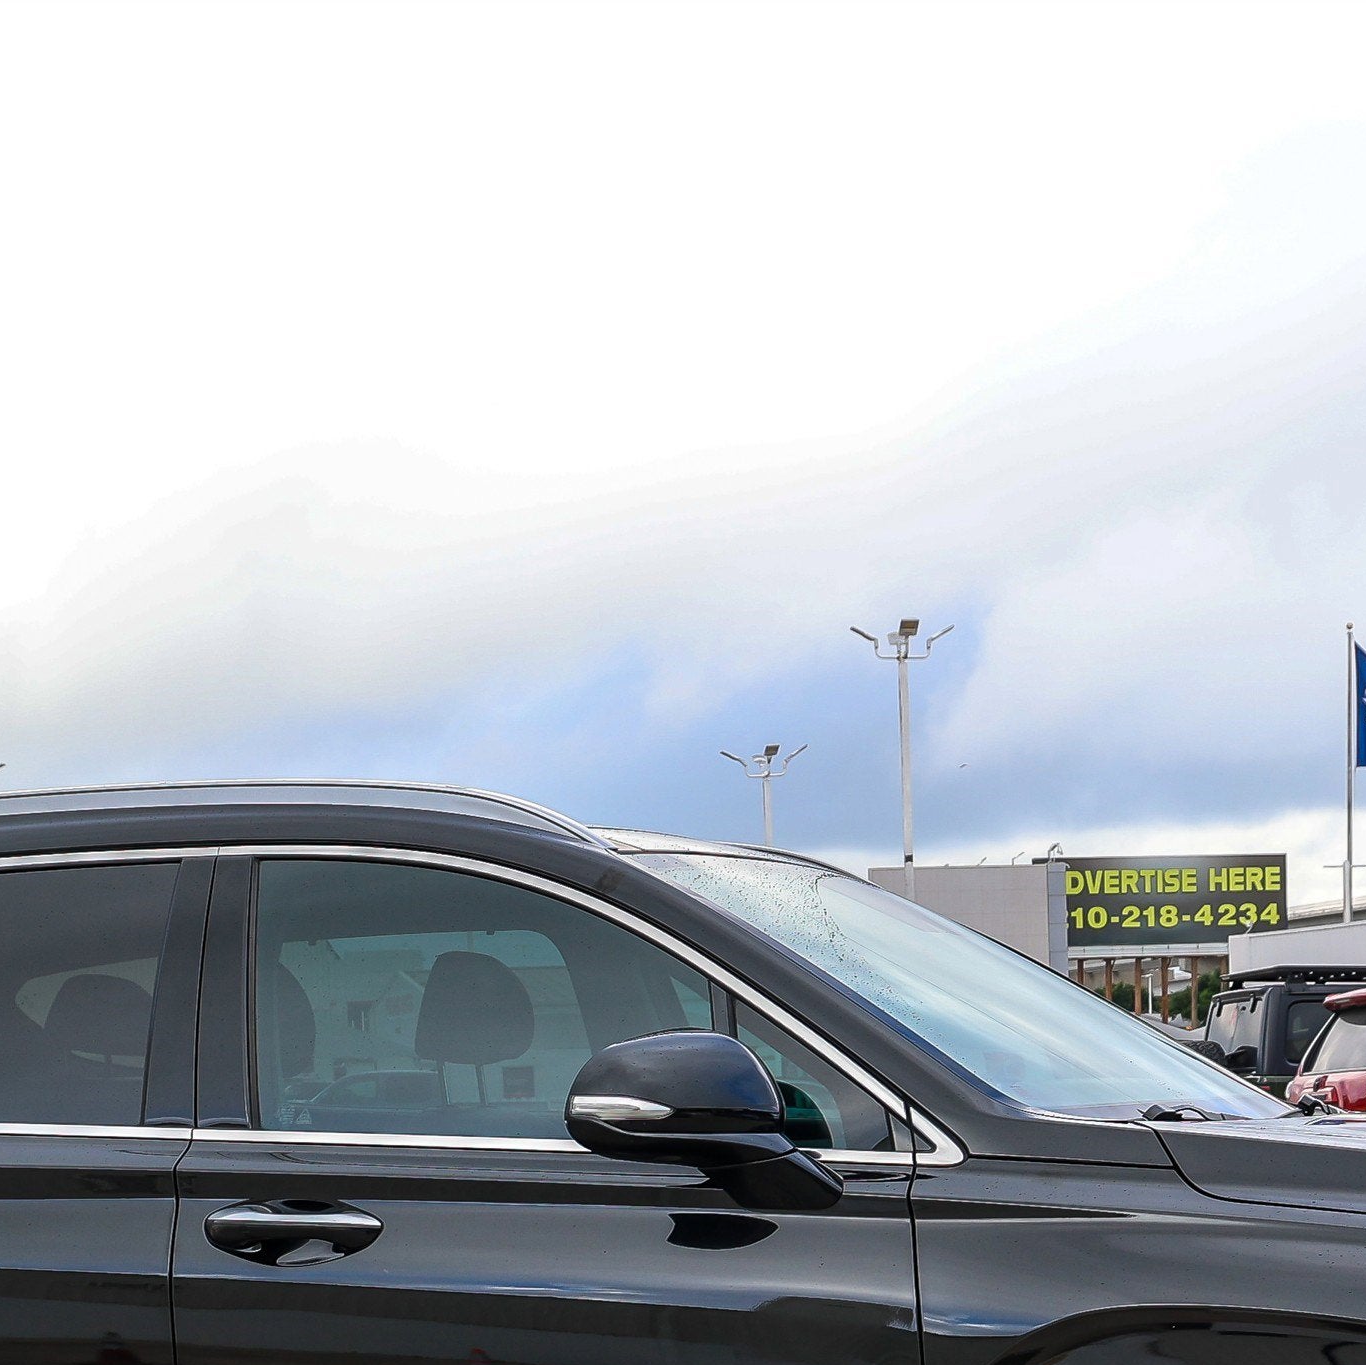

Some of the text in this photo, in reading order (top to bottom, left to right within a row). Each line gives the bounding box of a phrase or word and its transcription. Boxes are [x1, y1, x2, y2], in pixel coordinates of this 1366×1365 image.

[1065, 866, 1281, 895] DVERTISE HERE
[1066, 902, 1281, 929] 10-218-4234
